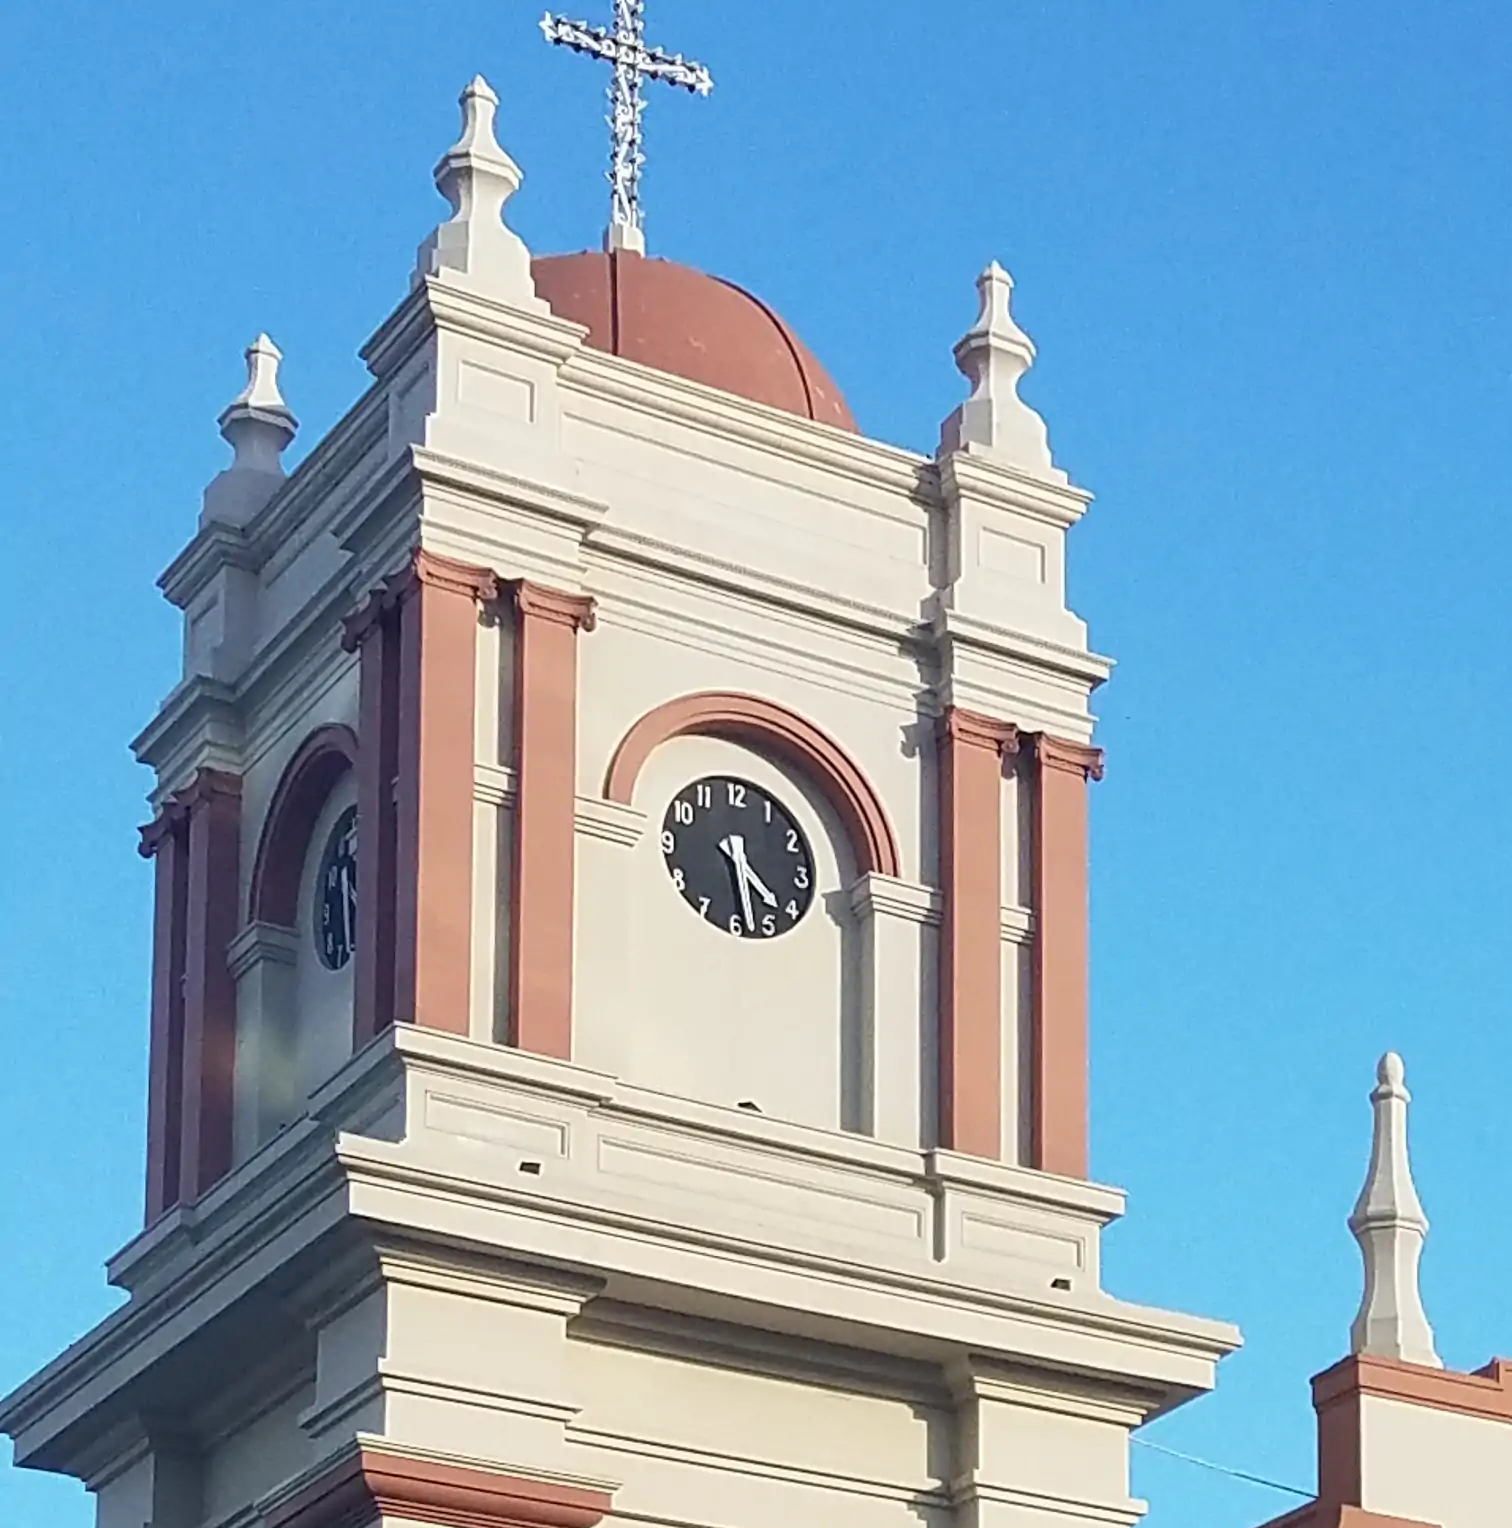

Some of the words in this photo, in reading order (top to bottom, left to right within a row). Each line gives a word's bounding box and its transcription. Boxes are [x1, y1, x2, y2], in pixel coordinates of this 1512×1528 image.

[697, 784, 711, 808] 11
[727, 783, 748, 808] 12
[674, 800, 694, 825] 10
[764, 801, 772, 823] 1
[661, 831, 675, 854] 9
[786, 829, 799, 853] 2
[672, 868, 686, 891] 8
[794, 866, 809, 888] 3
[698, 897, 711, 918] 7
[785, 900, 799, 920] 4
[729, 915, 742, 937] 6
[762, 915, 776, 936] 5
